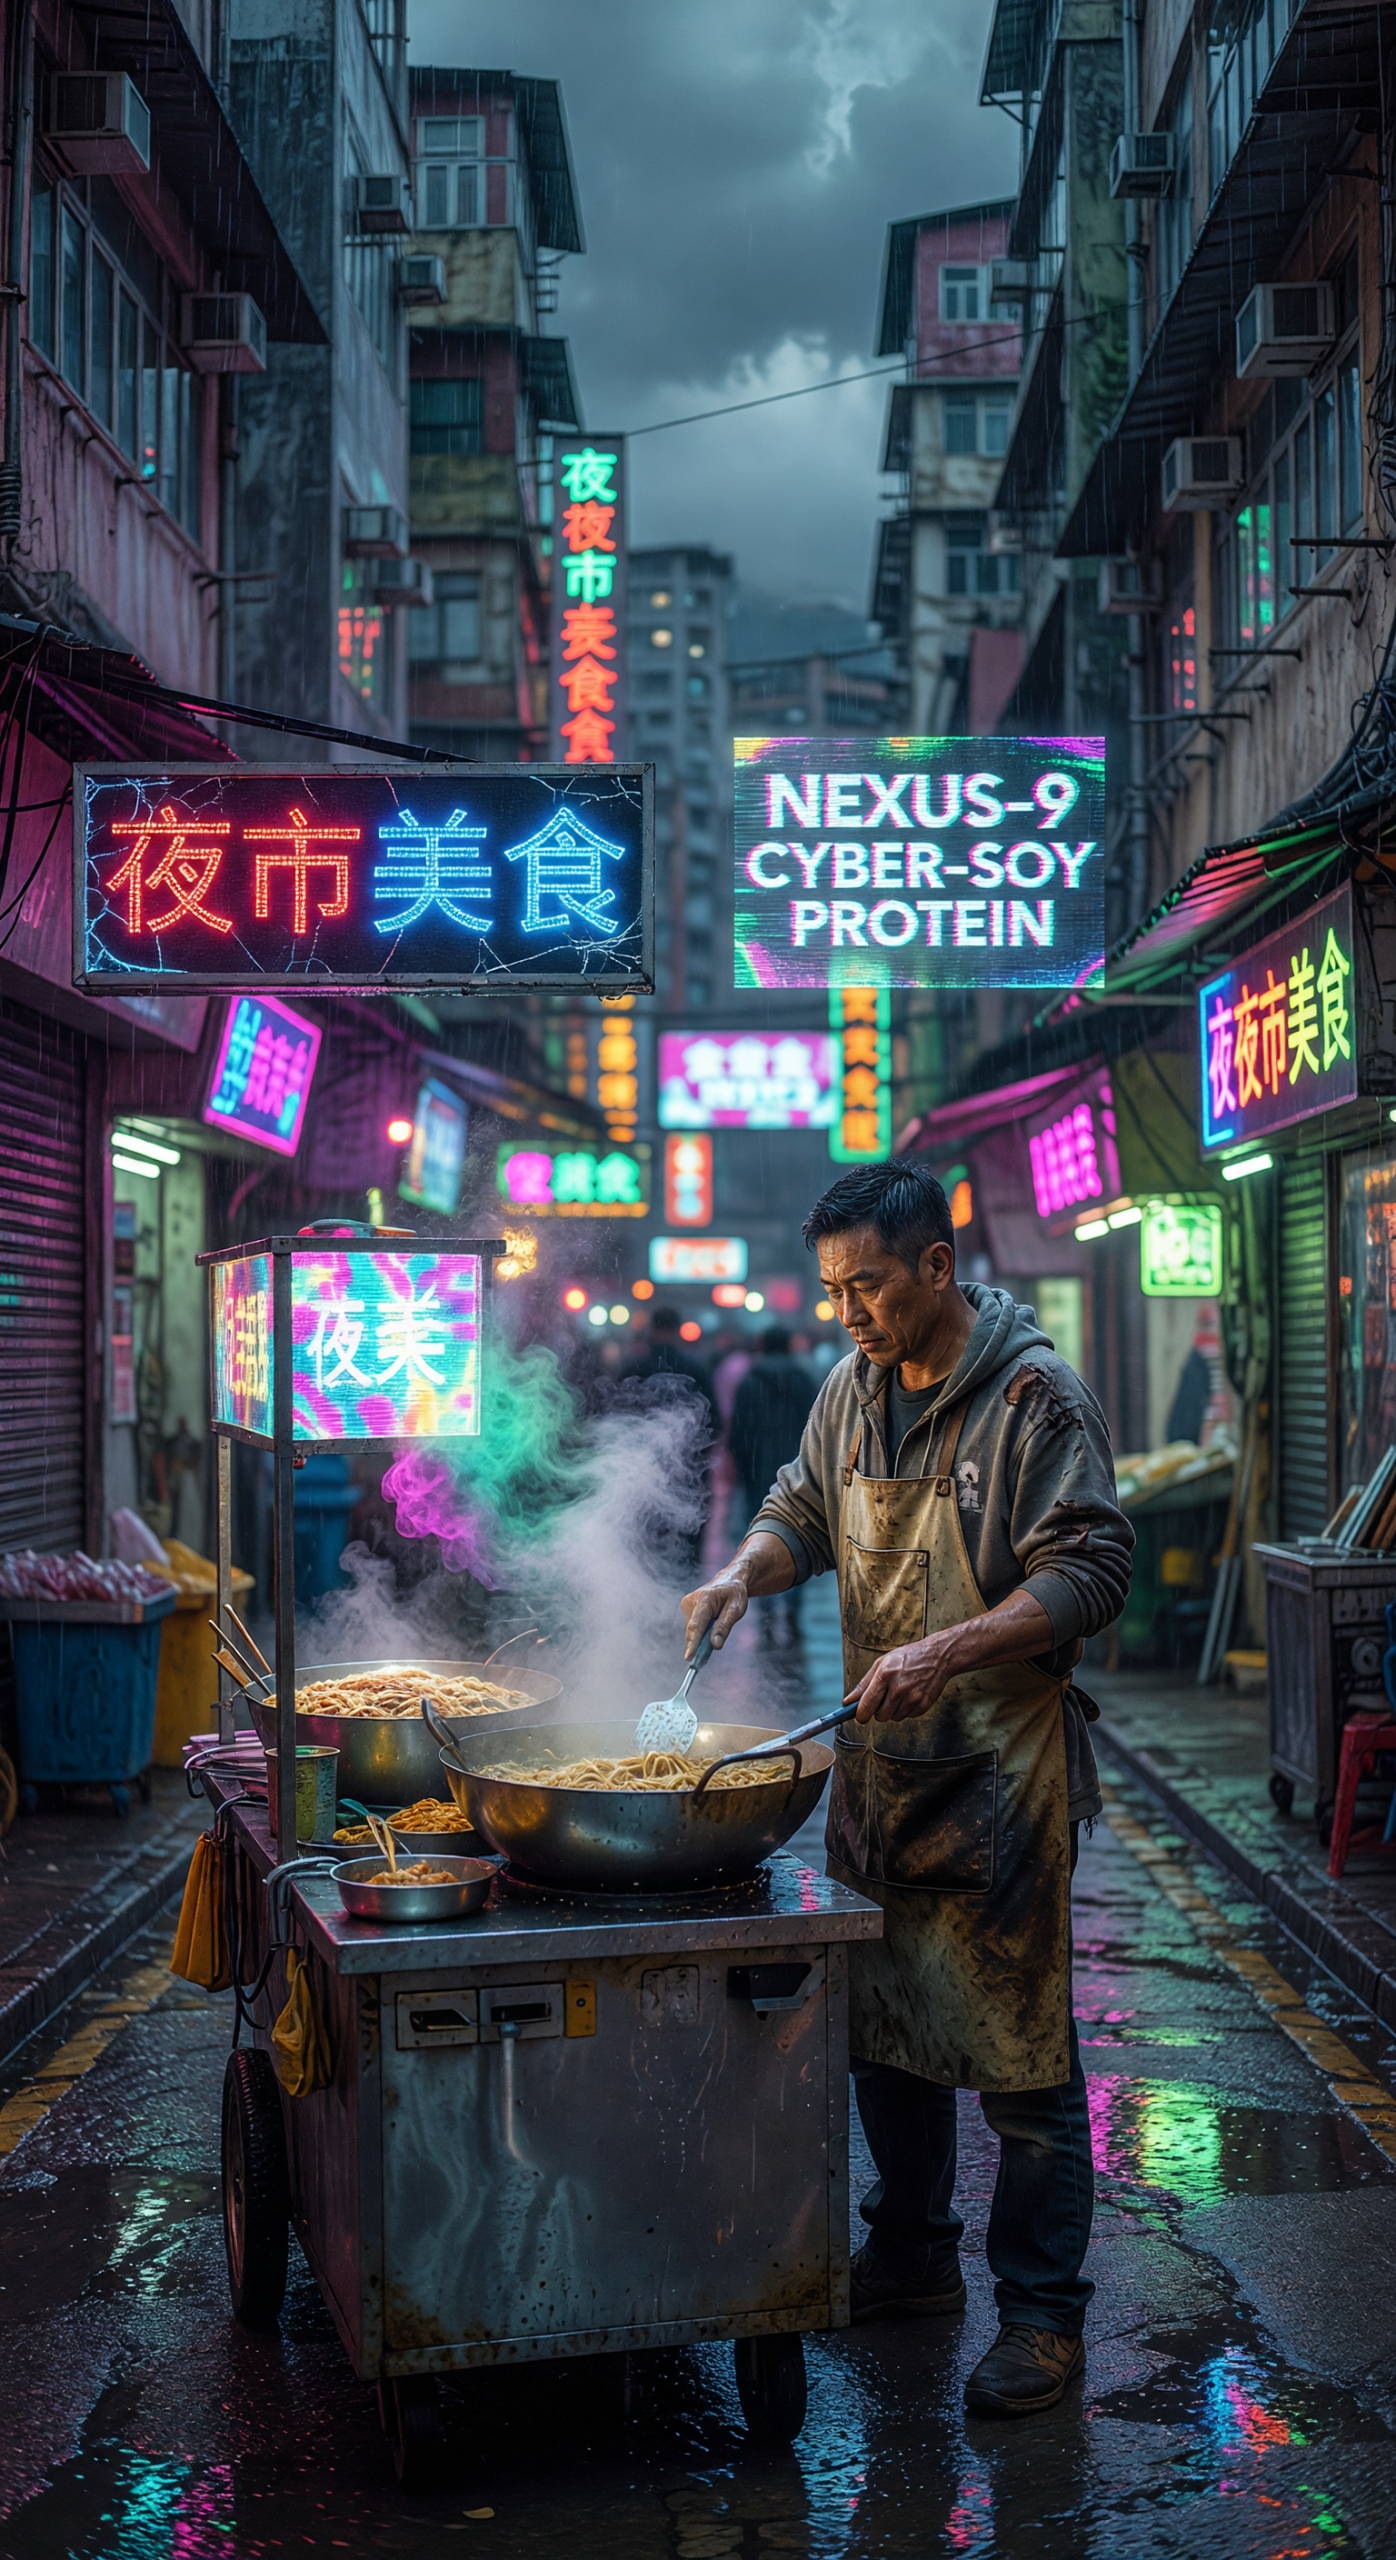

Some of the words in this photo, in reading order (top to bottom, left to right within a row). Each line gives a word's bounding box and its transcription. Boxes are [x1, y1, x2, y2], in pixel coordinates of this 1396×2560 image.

[764, 772, 1080, 829] NEXUS-9
[106, 806, 627, 936] 夜市美食
[744, 841, 1097, 889] CYBER-SOY
[789, 899, 1055, 946] PROTEIN
[1207, 927, 1351, 1120] 夜夜市美食
